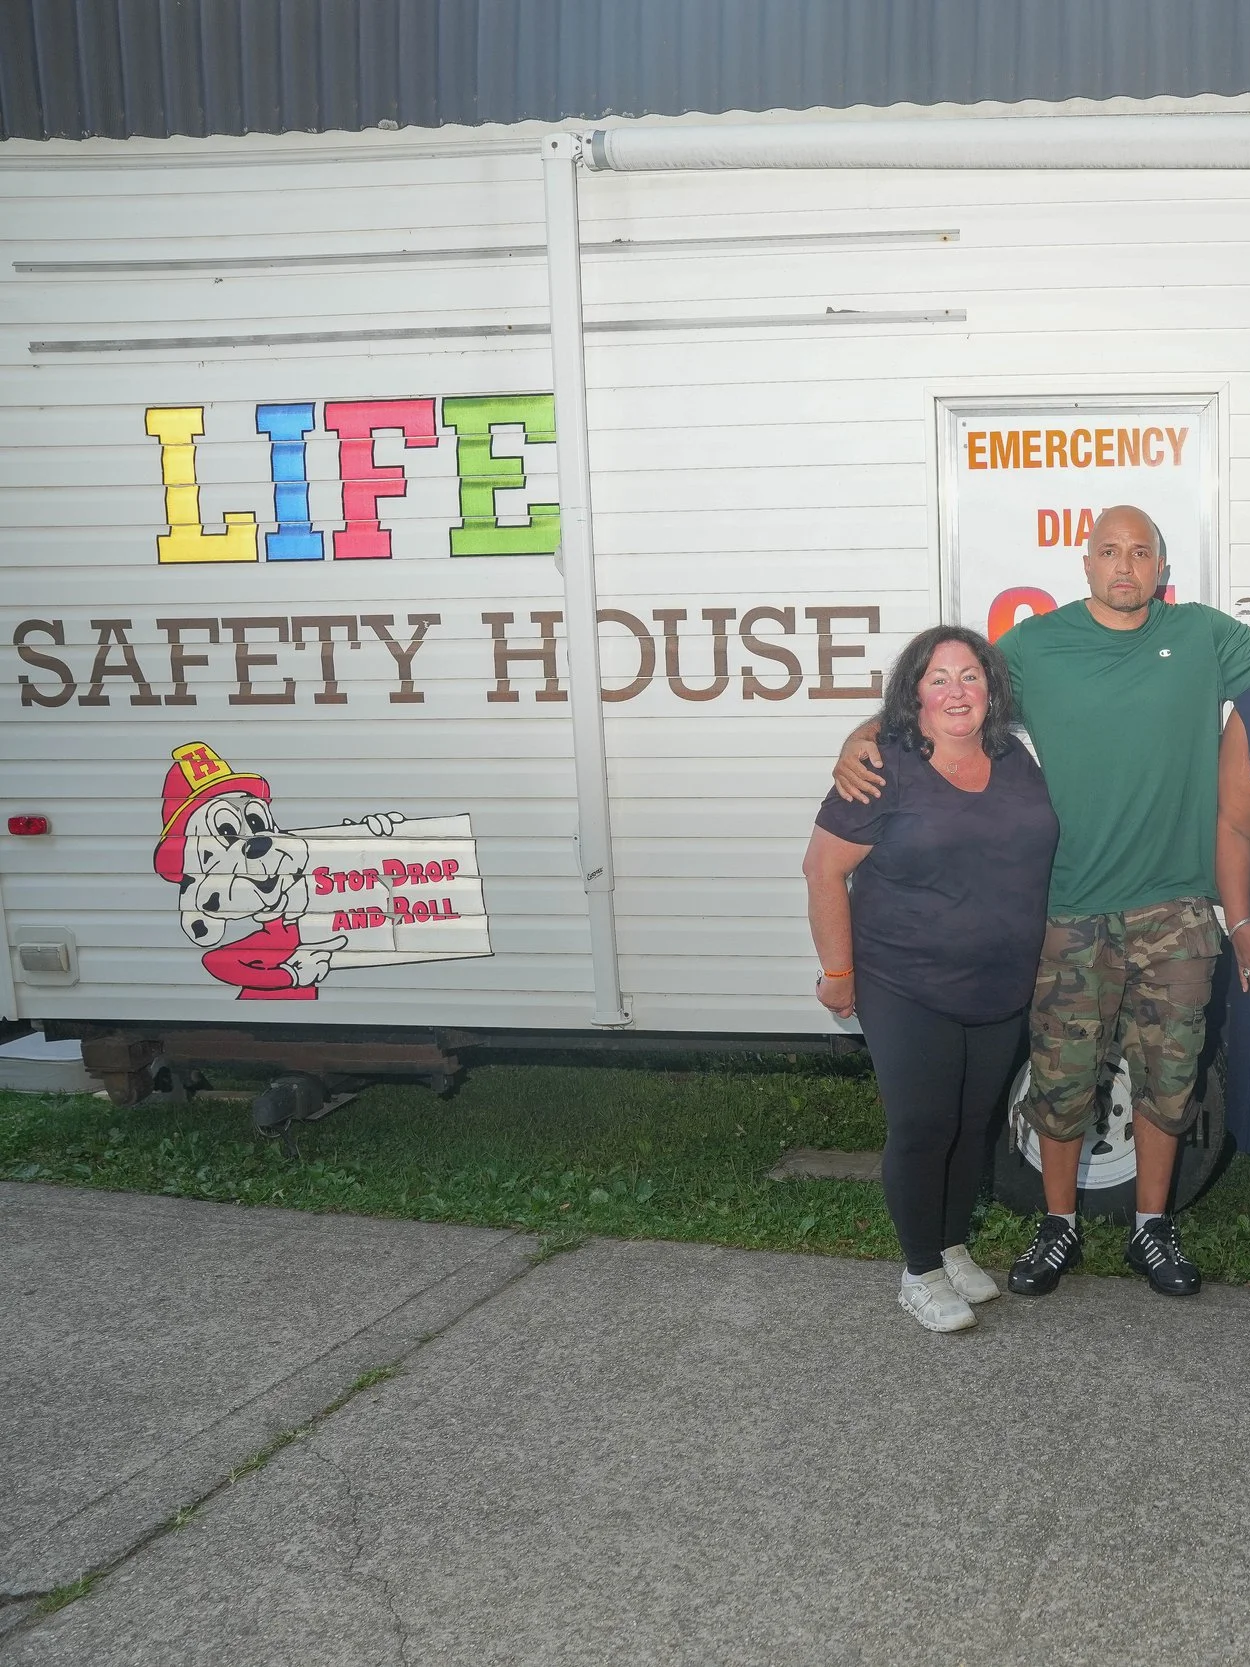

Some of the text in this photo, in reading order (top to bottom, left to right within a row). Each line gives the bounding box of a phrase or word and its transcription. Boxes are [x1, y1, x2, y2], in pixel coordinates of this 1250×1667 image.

[145, 393, 561, 564] LIFE
[1038, 508, 1108, 547] DIA
[13, 613, 441, 707] SAFETY
[481, 606, 883, 702] HOUSE
[181, 746, 221, 782] H
[382, 858, 460, 888] DROP
